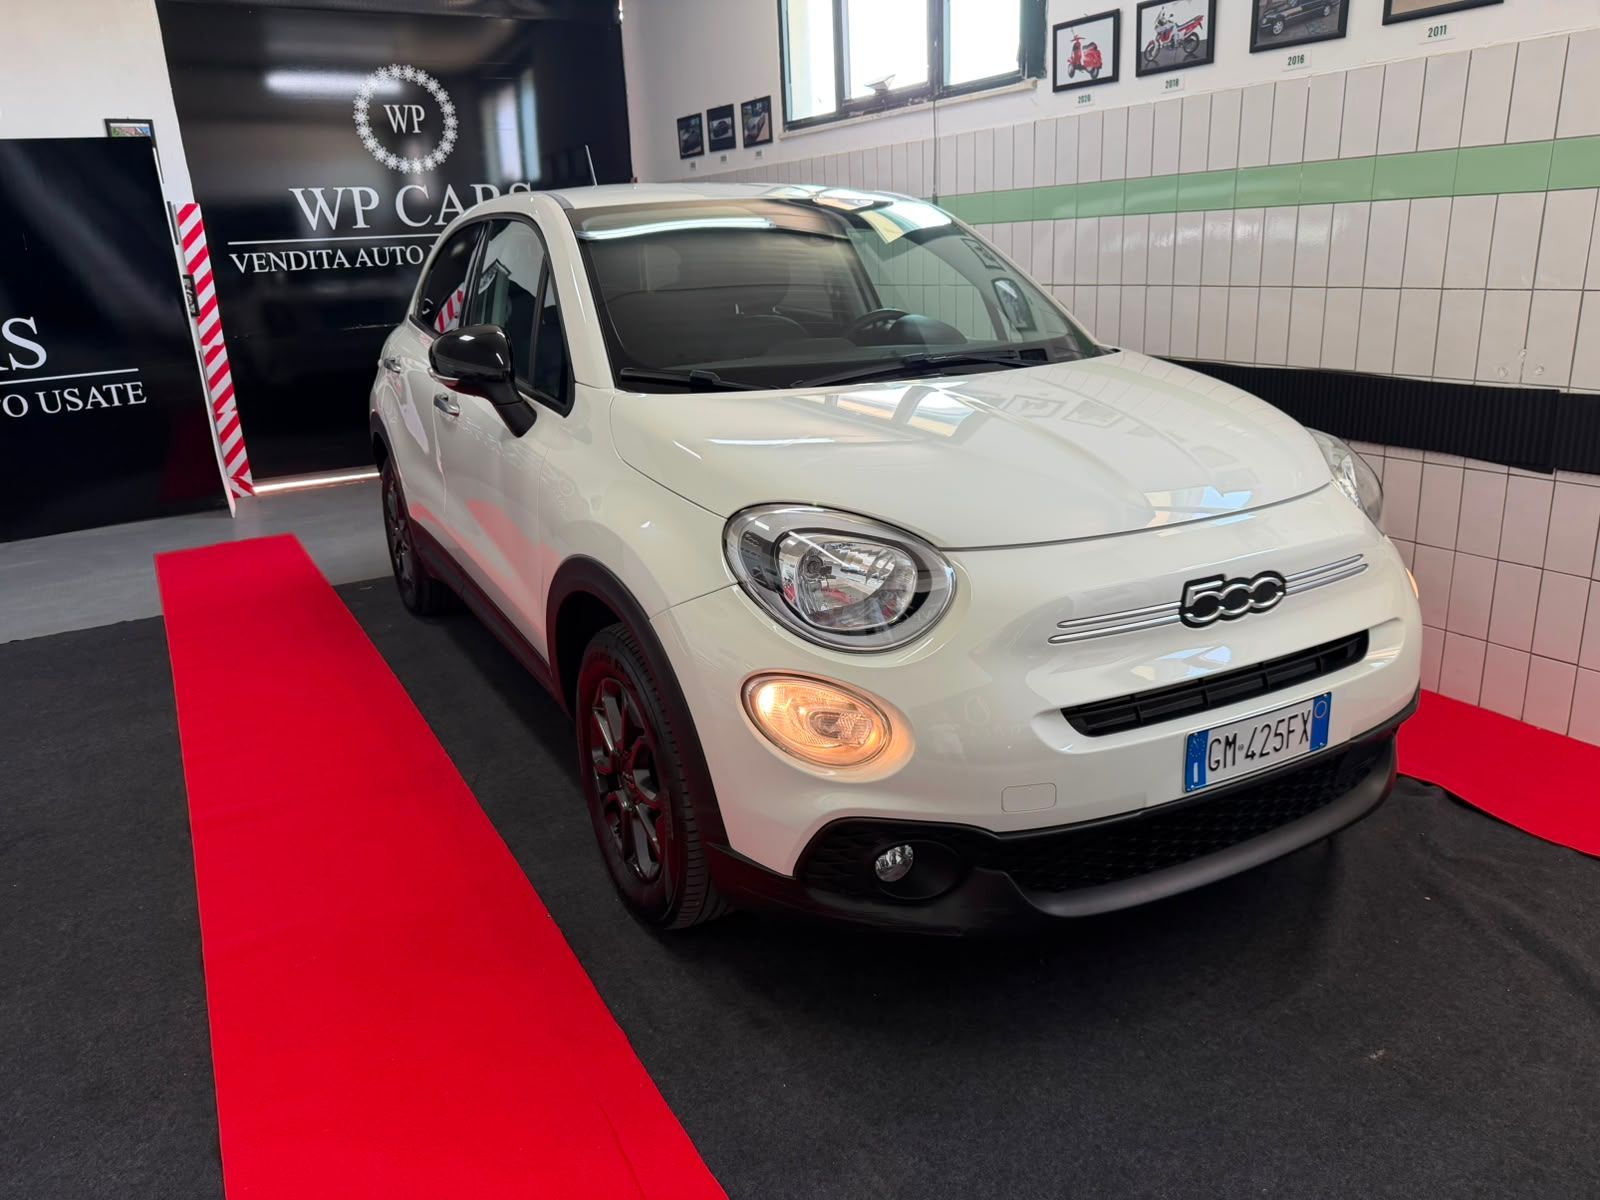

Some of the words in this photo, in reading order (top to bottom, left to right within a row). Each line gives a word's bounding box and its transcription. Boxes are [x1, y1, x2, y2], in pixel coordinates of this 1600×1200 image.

[1427, 25, 1447, 38] 2011
[1287, 54, 1305, 66] 2016
[383, 104, 425, 134] WP
[288, 186, 380, 231] WP
[395, 182, 531, 227] CA
[228, 249, 353, 274] VENDITA
[356, 244, 424, 267] AUTO
[0, 316, 47, 371] S
[35, 381, 147, 414] USATE
[1180, 571, 1286, 626] 500
